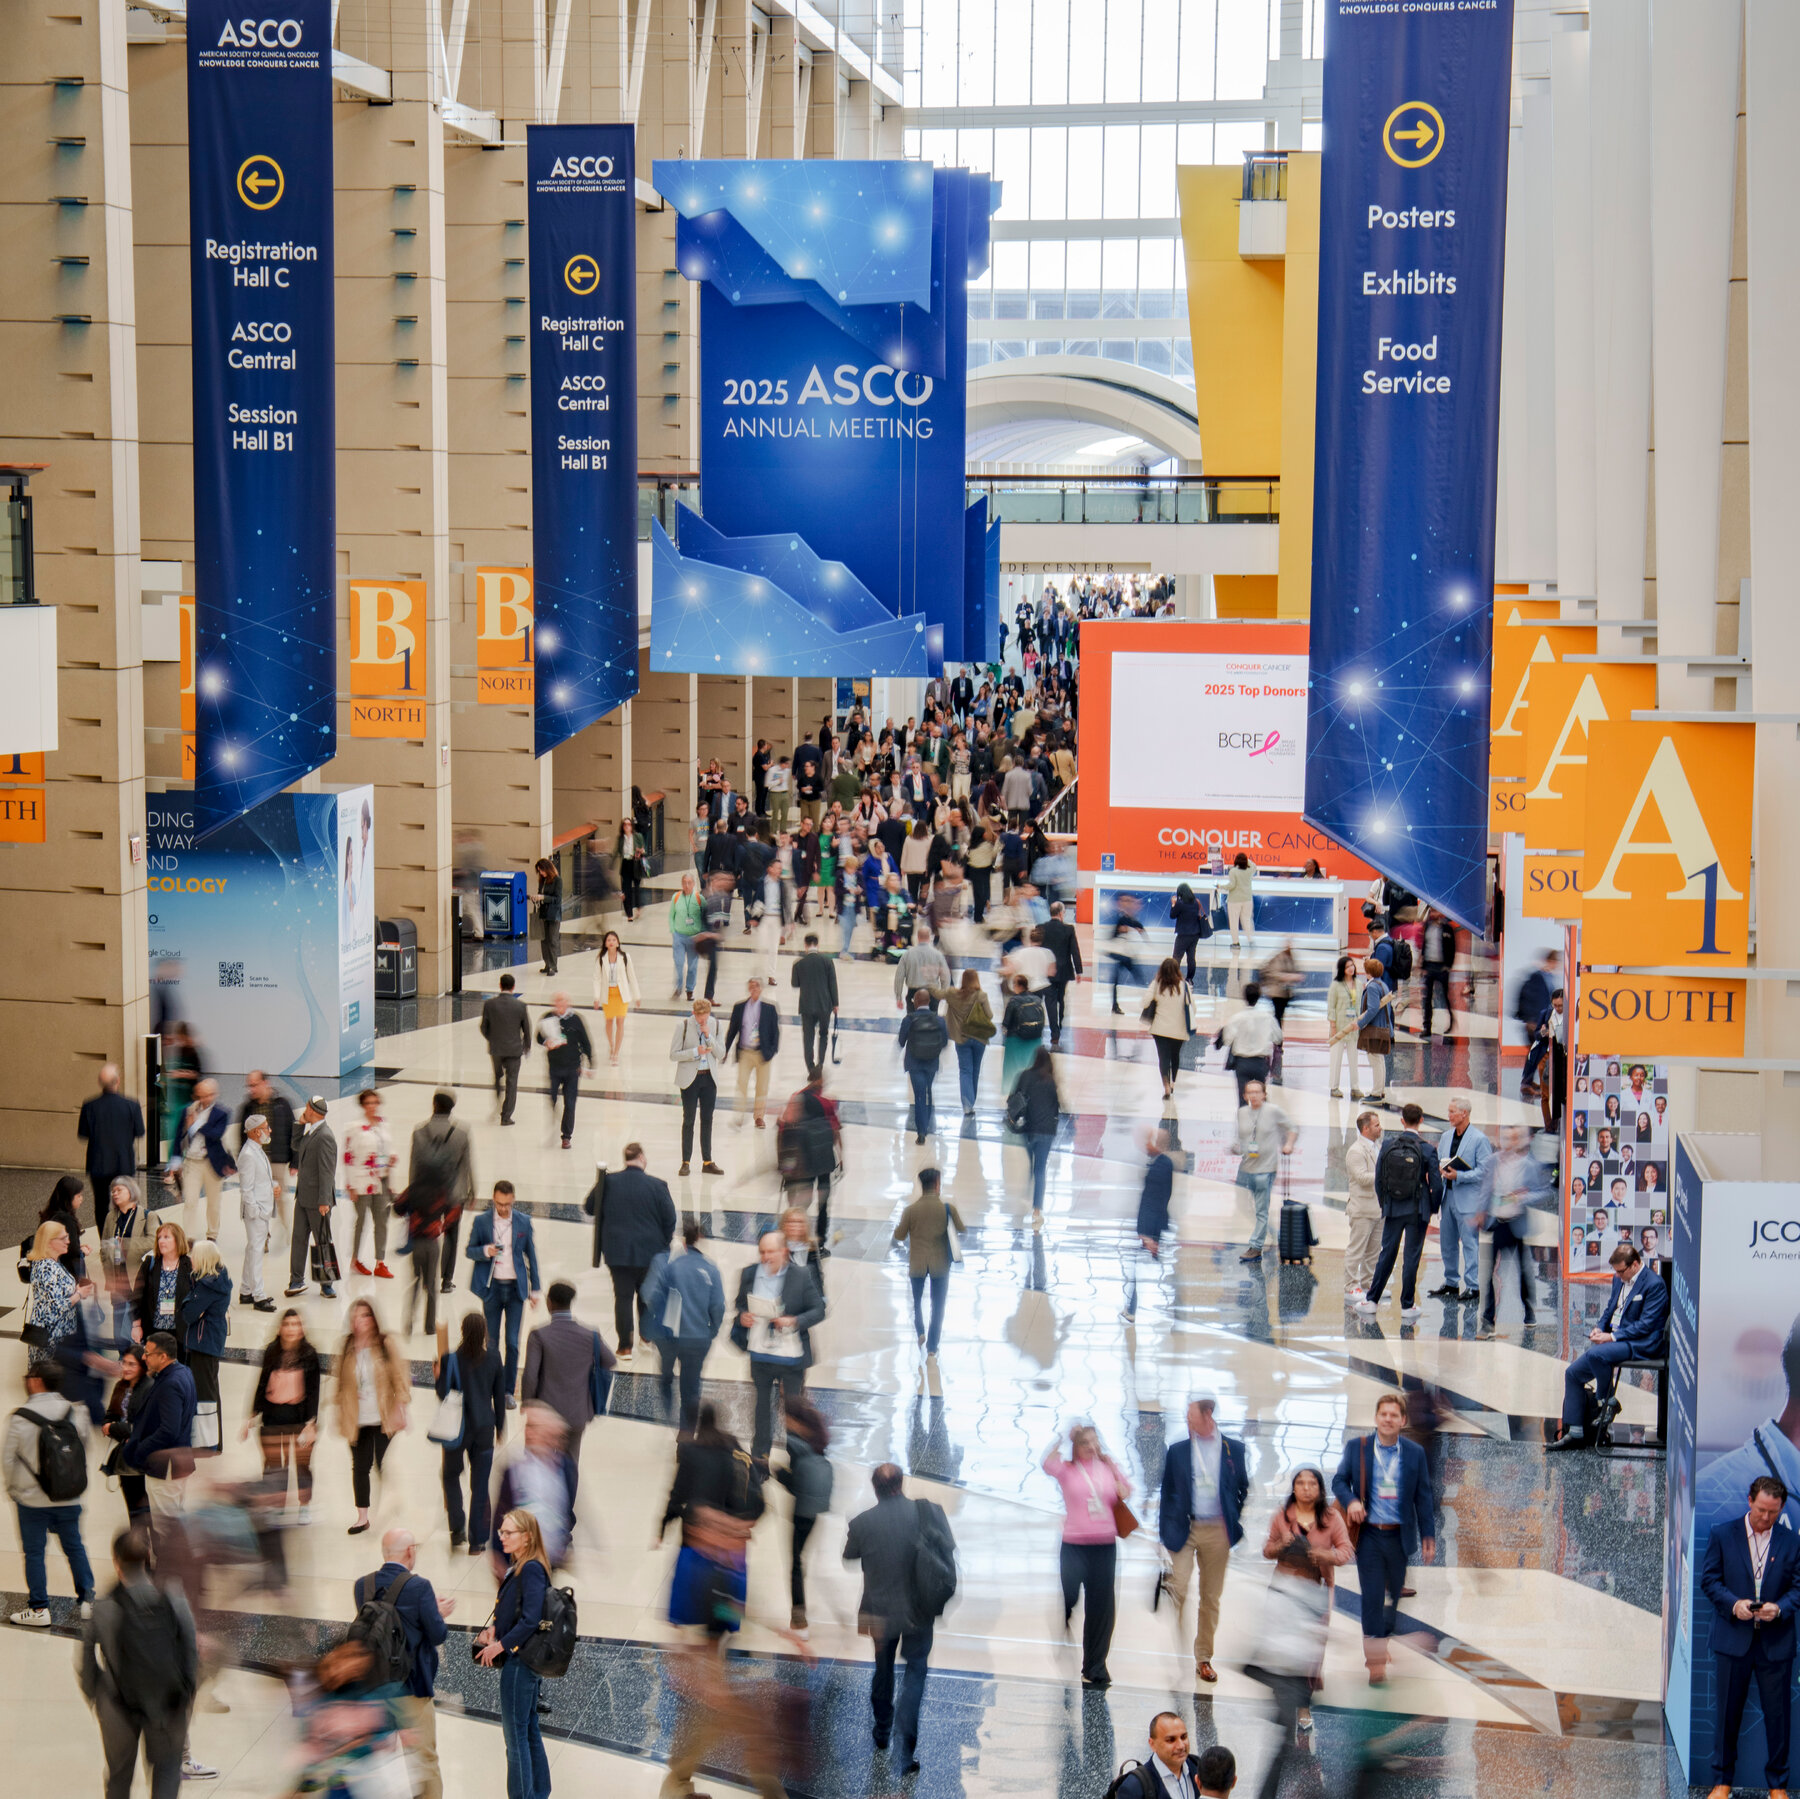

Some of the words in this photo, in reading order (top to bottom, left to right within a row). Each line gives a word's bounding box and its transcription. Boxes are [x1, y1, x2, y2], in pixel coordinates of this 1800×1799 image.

[1339, 4, 1399, 15] KNOWLEDGE
[1402, 2, 1455, 13] CONQUERS
[1457, 0, 1497, 10] CANCER
[217, 18, 302, 48] ASCO
[199, 60, 246, 68] KNOWLEDGE
[247, 60, 288, 68] CONQUERS
[289, 60, 320, 69] CANCER
[550, 156, 614, 178] ASCO
[1367, 205, 1456, 229] Posters
[205, 238, 318, 265] Registration
[233, 266, 269, 287] Hall
[274, 267, 290, 288] C
[1362, 269, 1457, 295] Exhibits
[231, 321, 292, 343] ASCO
[541, 315, 625, 335] Registration
[562, 335, 589, 351] Hall
[592, 336, 604, 351] C
[1378, 335, 1438, 361] Food
[227, 348, 296, 370] Central
[560, 375, 606, 391] ASCO
[722, 379, 788, 405] 2025
[797, 363, 933, 407] ASCO
[1361, 370, 1452, 395] Service
[228, 402, 298, 425] Session
[557, 395, 610, 411] Central
[722, 417, 822, 439] ANNUAL
[828, 417, 934, 440] MEETING
[232, 430, 268, 450] Hall
[273, 432, 293, 451] B1
[558, 435, 610, 451] Session
[561, 454, 588, 470] Hall
[591, 455, 607, 470] B1
[1042, 562, 1116, 573] CENTER
[1205, 684, 1235, 695] 2025
[1239, 684, 1260, 698] Top
[1264, 686, 1306, 697] Donors
[354, 706, 421, 722] NORTH
[1218, 732, 1263, 749] BCRF
[157, 833, 198, 850] WAY.
[1158, 828, 1264, 849] CONQUER
[1267, 832, 1341, 851] CANCE
[1159, 851, 1176, 859] THE
[1181, 852, 1207, 860] ASCO
[159, 949, 181, 957] Cloud
[1588, 988, 1736, 1023] SOUTH
[1749, 1220, 1800, 1248] JCO
[1752, 1250, 1767, 1260] An
